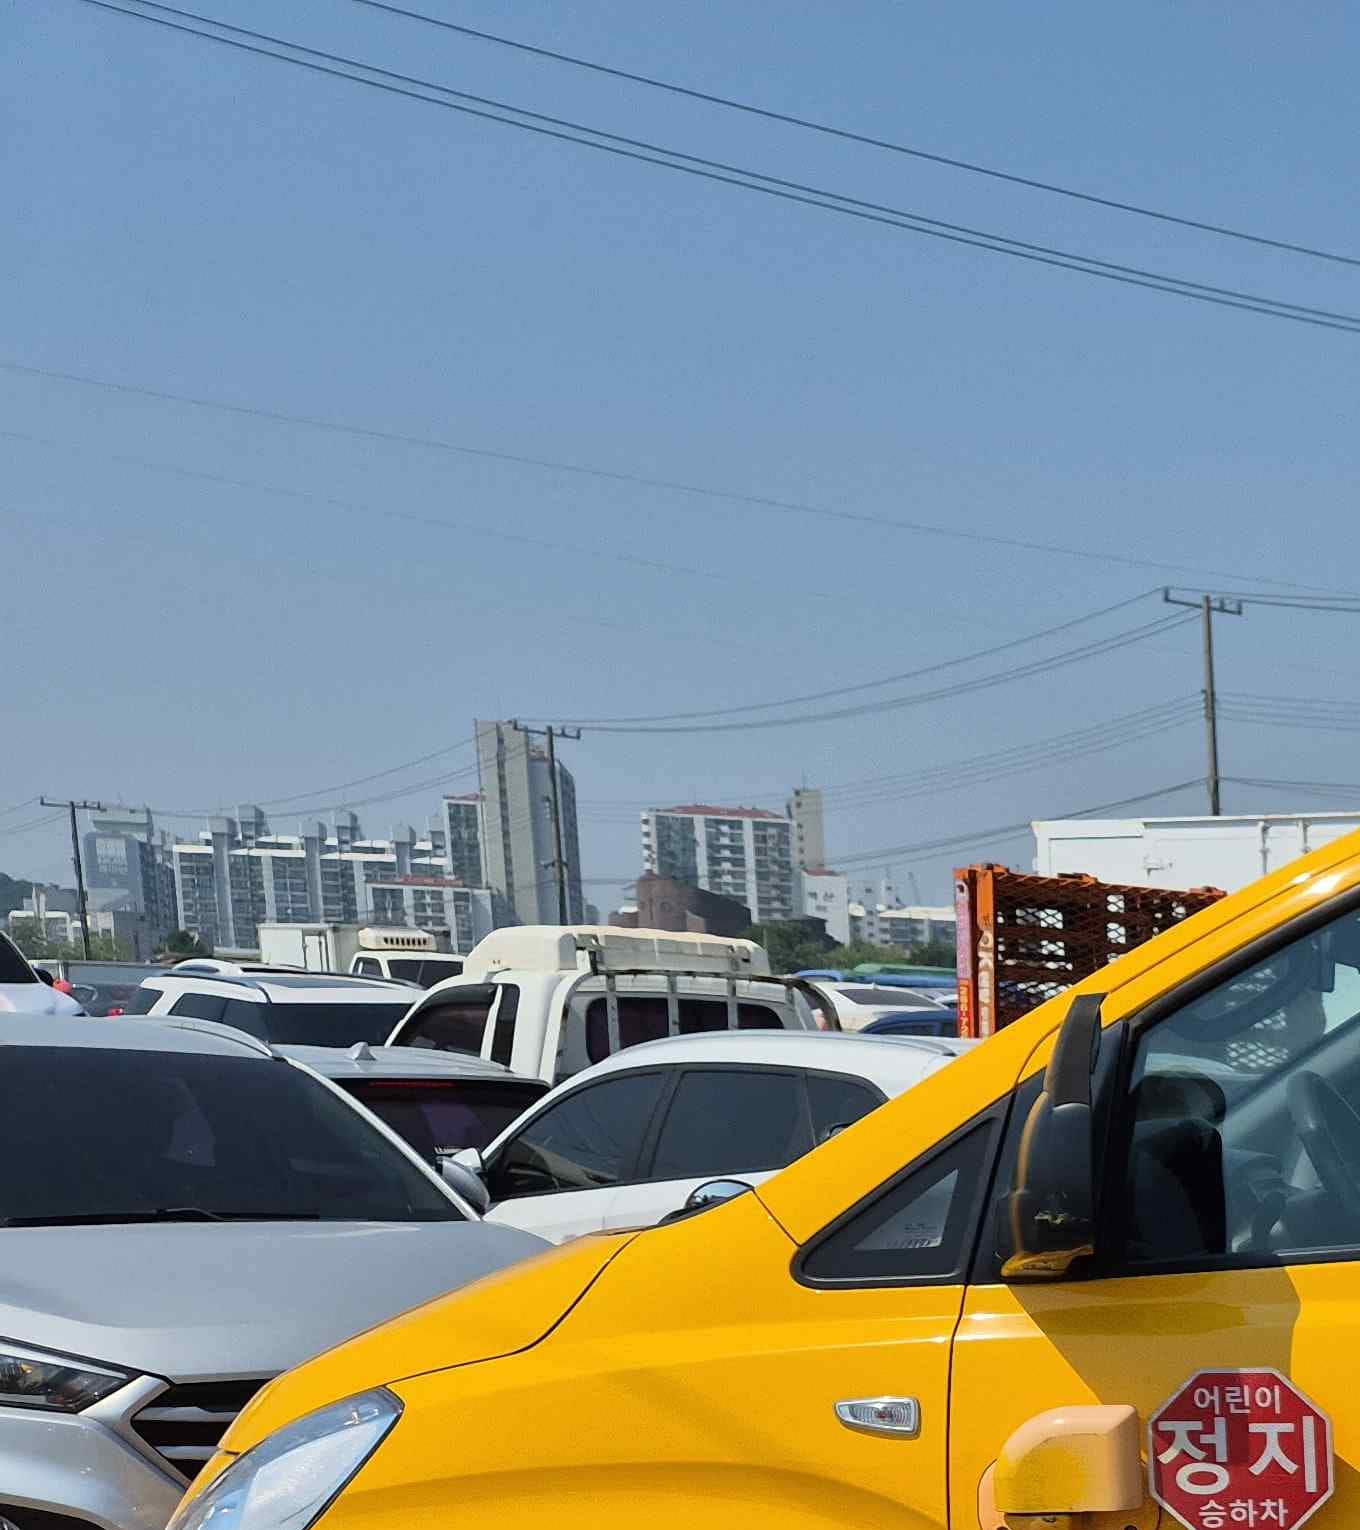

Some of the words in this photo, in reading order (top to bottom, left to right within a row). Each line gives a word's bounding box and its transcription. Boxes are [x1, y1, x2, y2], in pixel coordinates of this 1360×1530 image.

[1193, 1385, 1281, 1414] 어린이
[1157, 1415, 1317, 1495] 정지
[1199, 1498, 1289, 1528] 승하차
